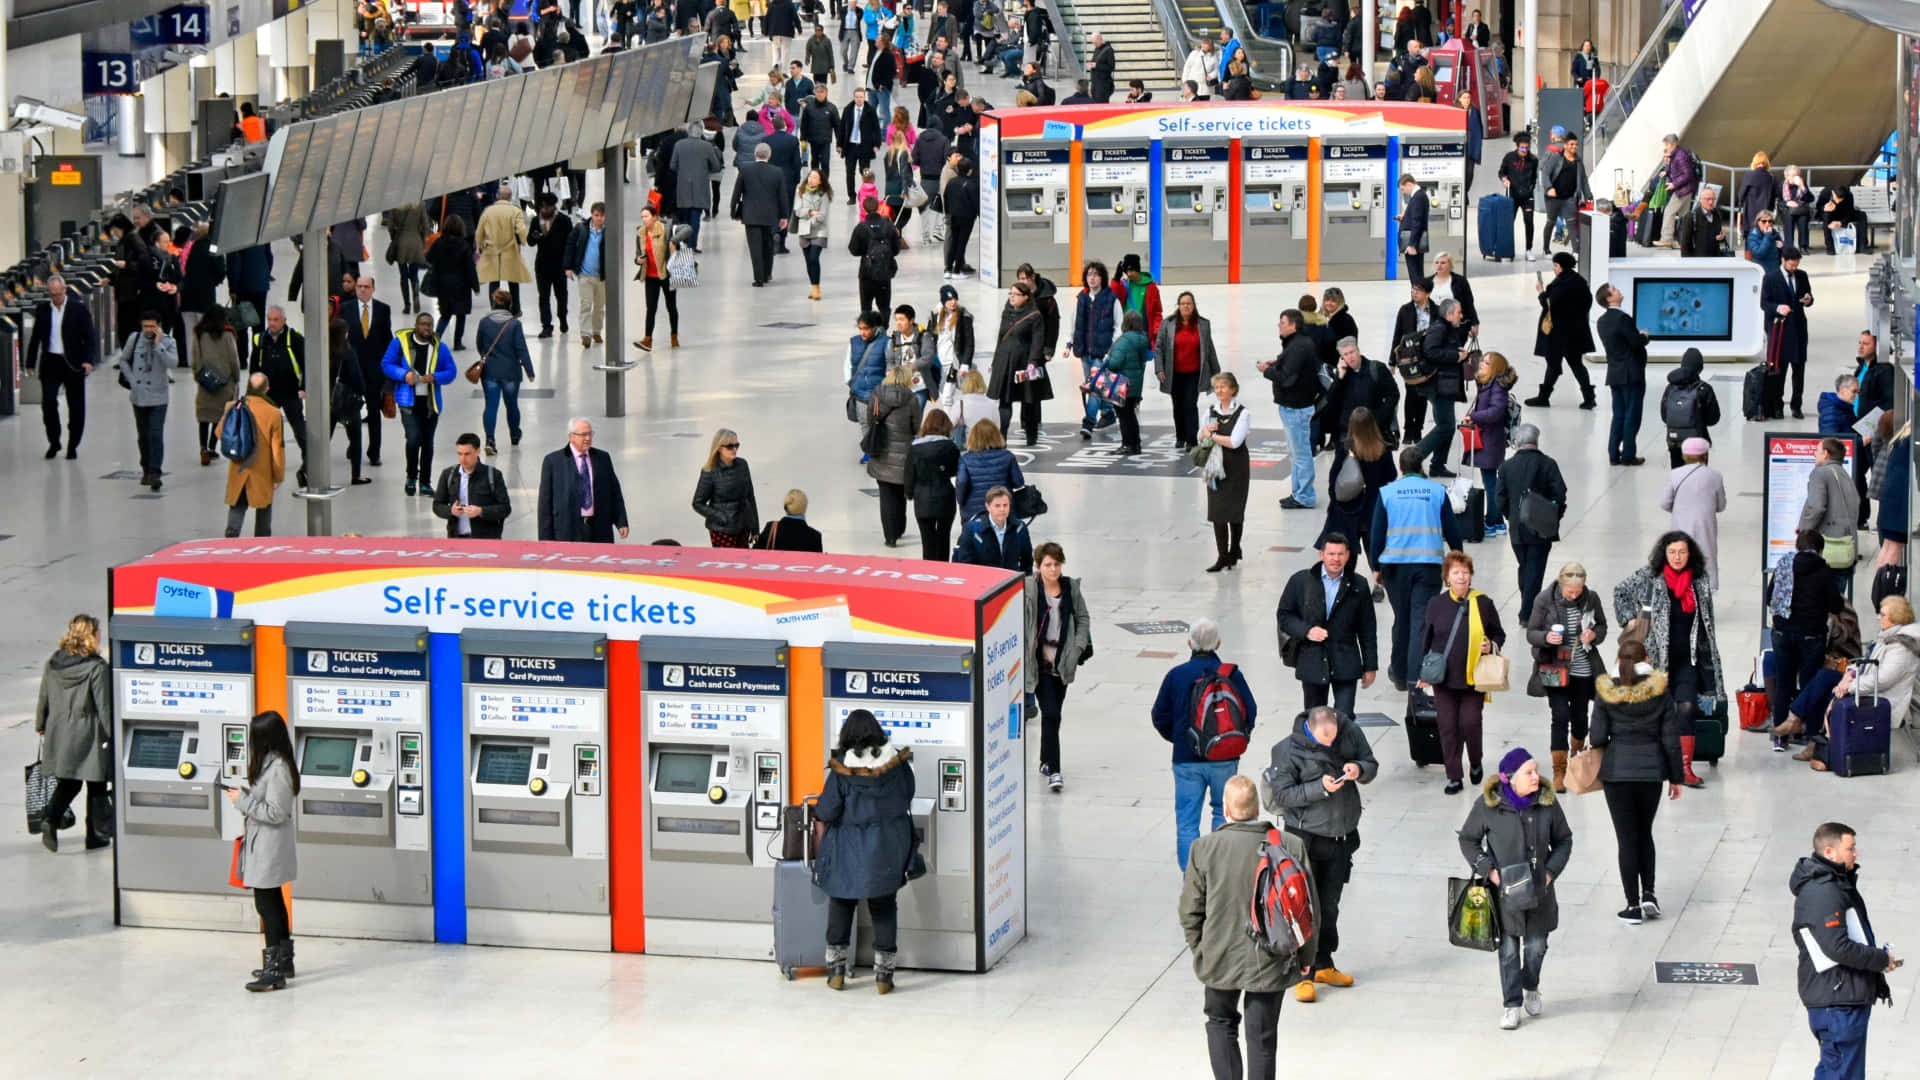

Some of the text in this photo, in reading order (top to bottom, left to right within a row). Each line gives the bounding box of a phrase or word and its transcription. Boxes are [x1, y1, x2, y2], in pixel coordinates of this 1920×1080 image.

[171, 13, 201, 37] 14
[97, 59, 128, 86] 13
[1159, 117, 1311, 133] Self-service tickets
[176, 545, 967, 585] Self-service ticket machines
[163, 585, 201, 600] oyster
[383, 586, 697, 625] Self-service tickets
[776, 616, 801, 624] SOUTH
[801, 613, 820, 621] WEST
[159, 643, 205, 655] TICKETS
[987, 632, 1019, 666] Self-service
[159, 657, 213, 668] Card Payments
[332, 651, 378, 662] TICKETS
[509, 658, 556, 670] TICKETS
[332, 665, 350, 673] Cash
[366, 666, 383, 675] Card
[384, 667, 421, 677] Payments
[509, 672, 565, 682] Card Payments
[688, 665, 736, 677] TICKETS
[872, 672, 920, 684] TICKETS
[987, 668, 1006, 692] tickets
[688, 680, 780, 692] Cash and Card Payments
[872, 686, 929, 697] Card Payments
